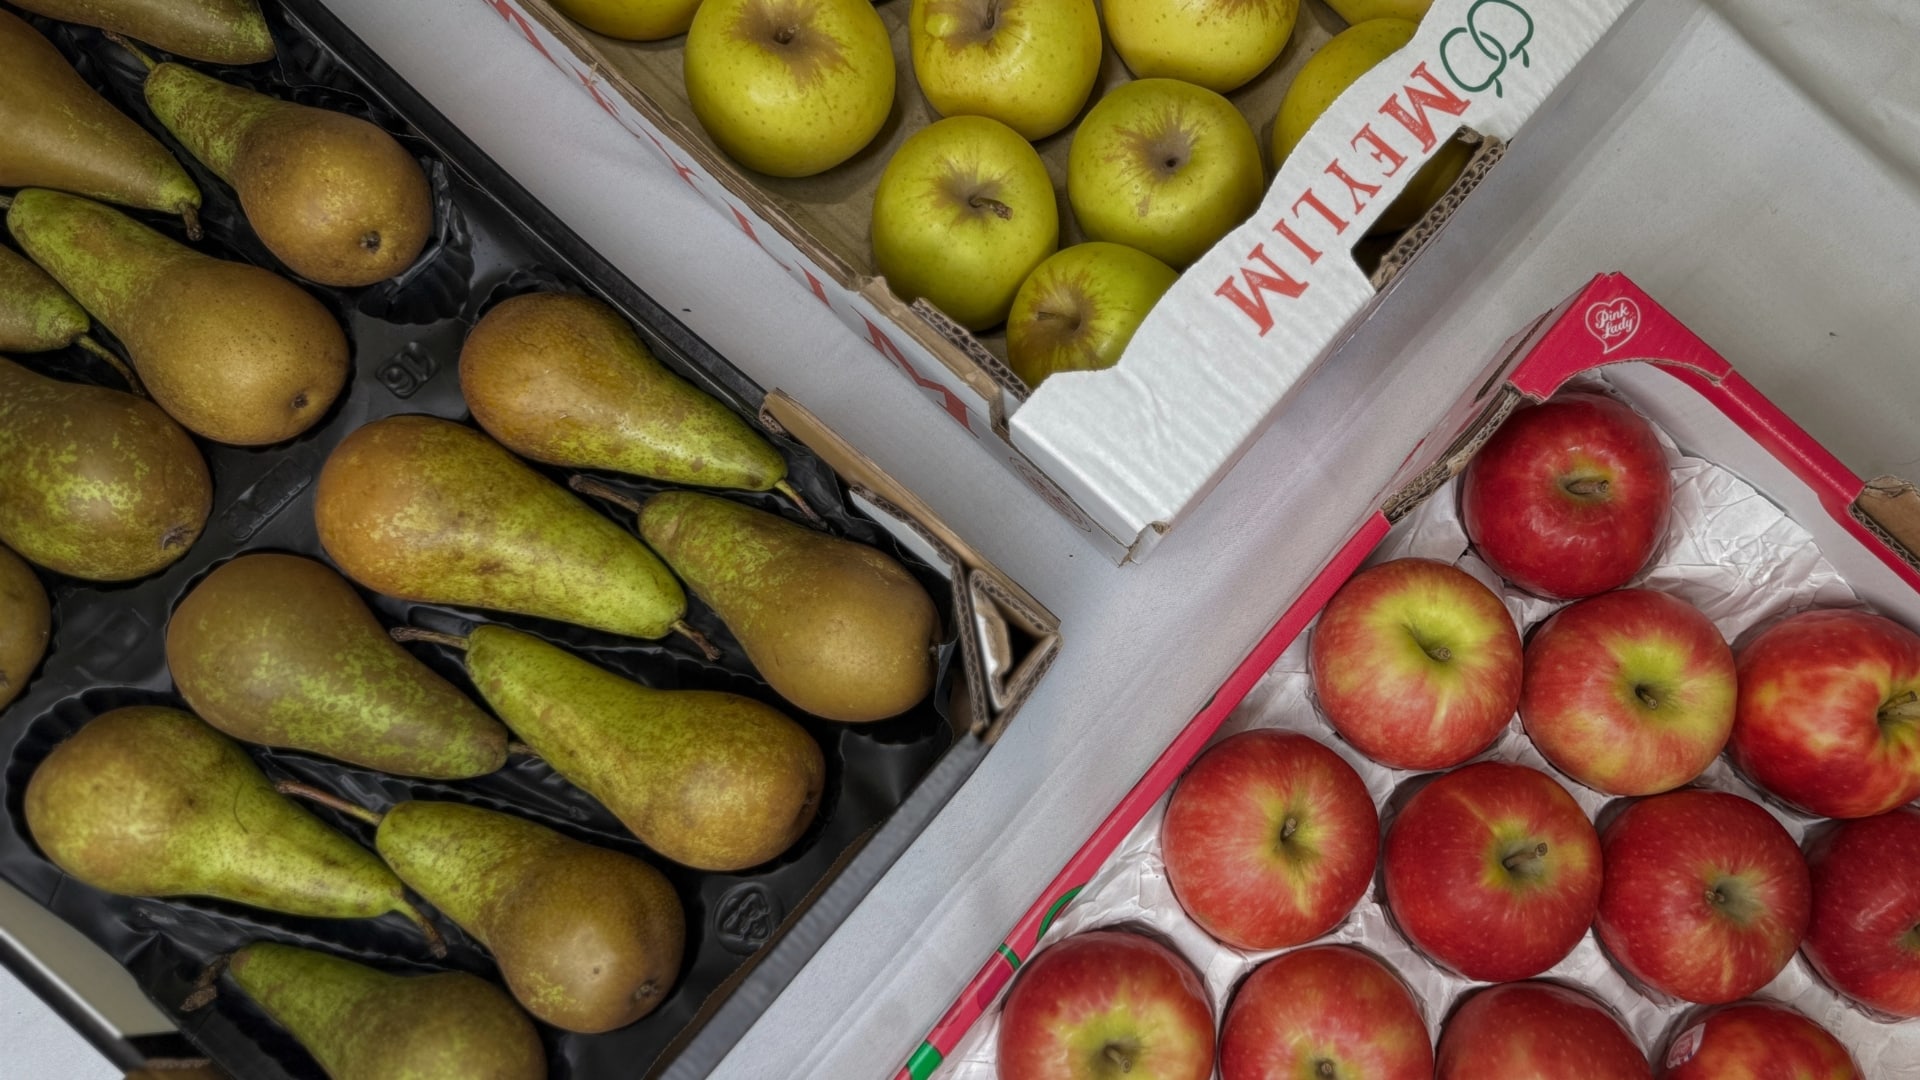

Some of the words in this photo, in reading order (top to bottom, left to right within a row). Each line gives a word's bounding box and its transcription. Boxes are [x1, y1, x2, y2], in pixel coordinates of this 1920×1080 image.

[1214, 60, 1472, 338] MEYLIM
[1595, 303, 1630, 329] Pink
[1602, 317, 1633, 339] Lady
